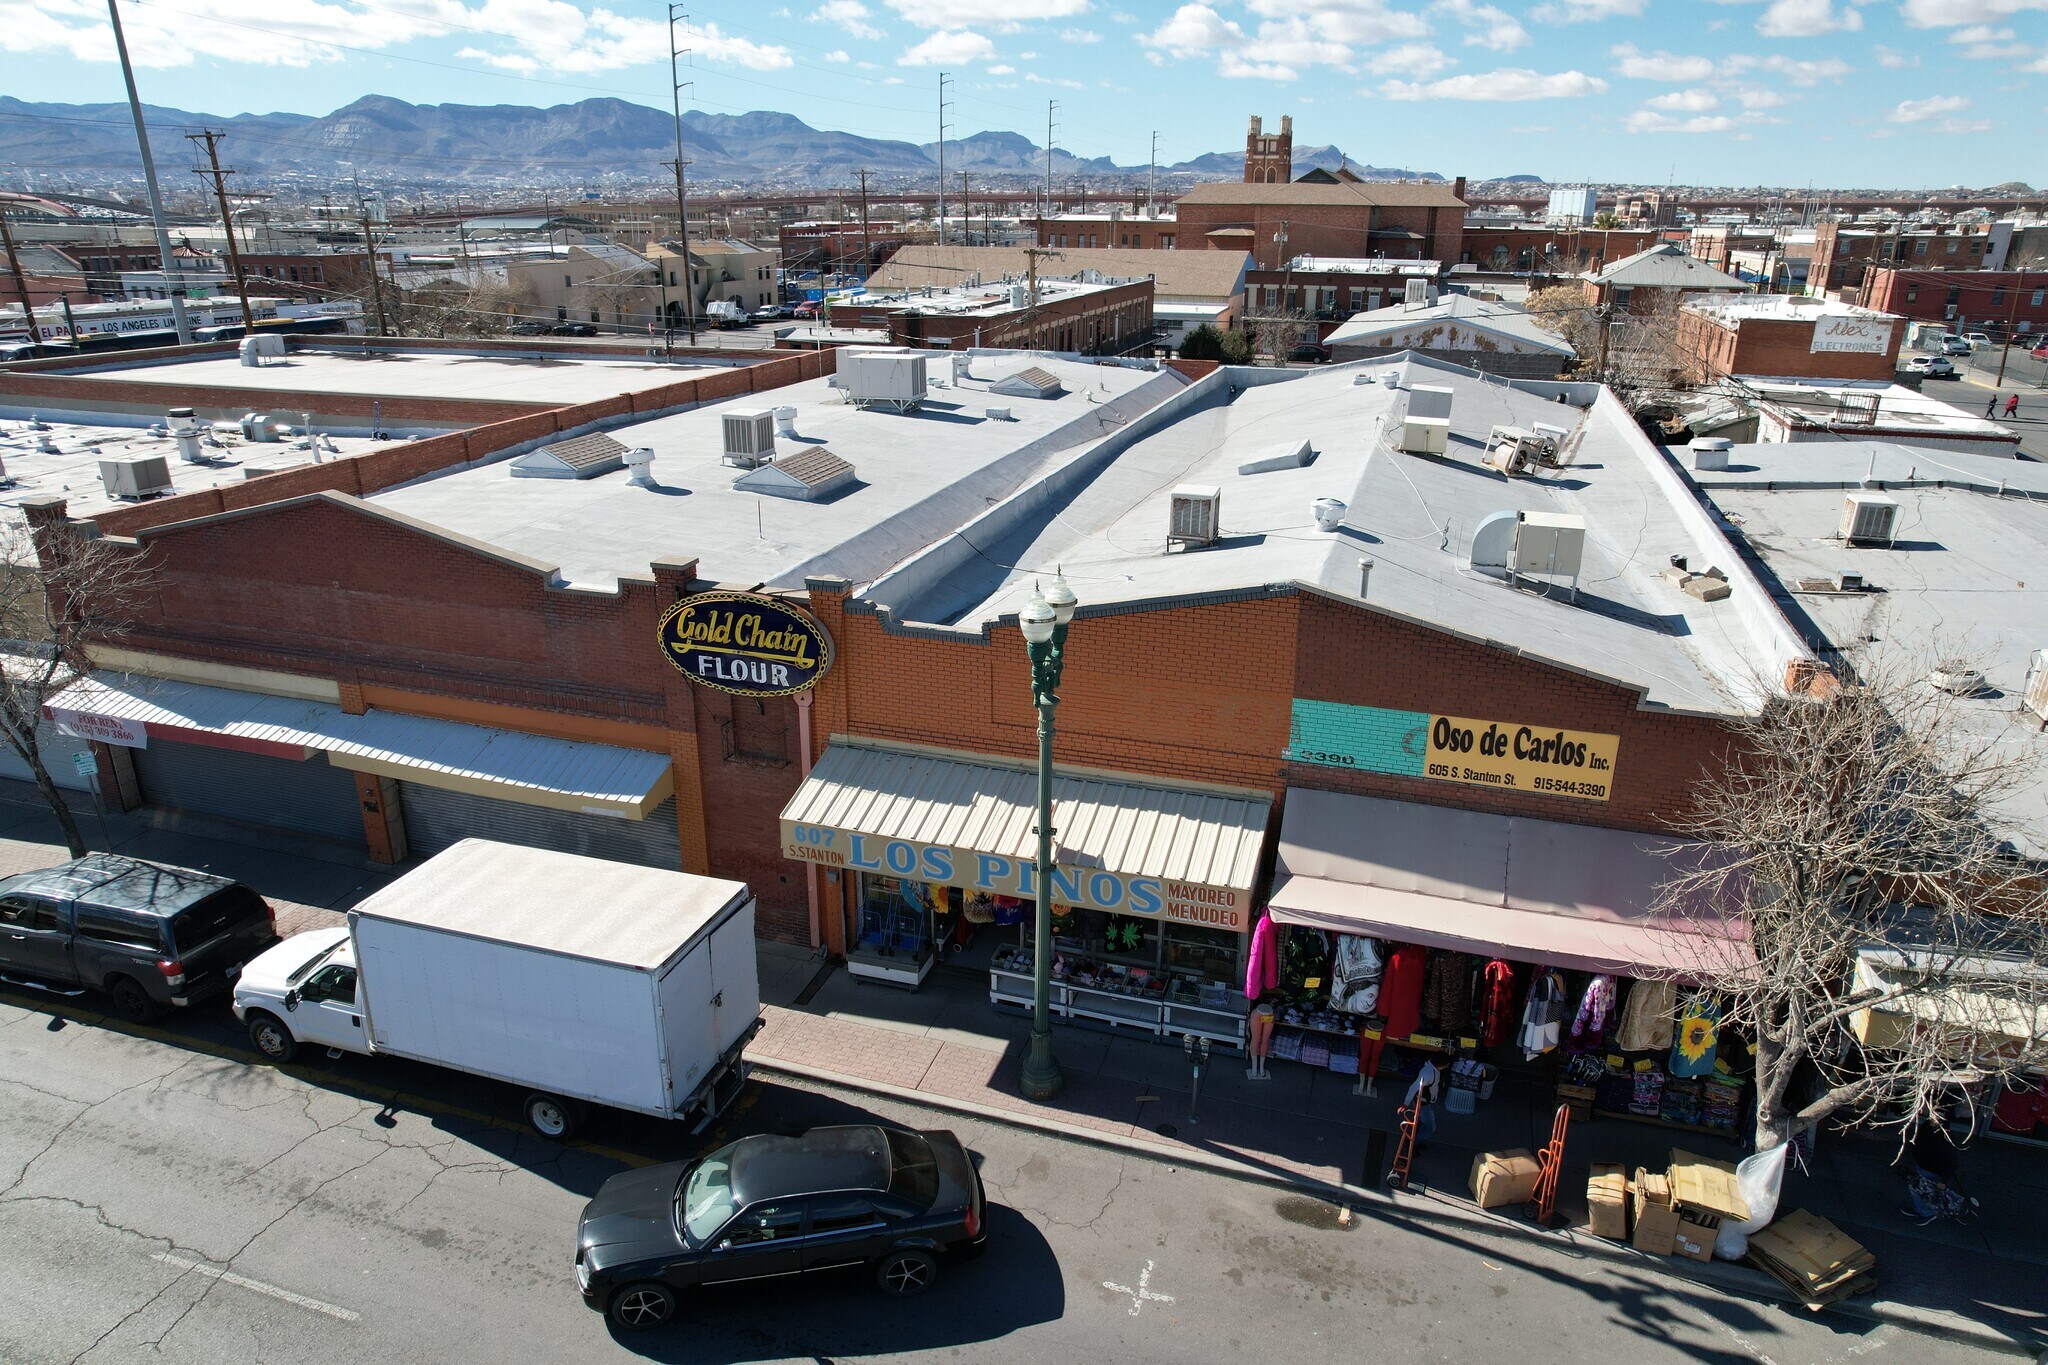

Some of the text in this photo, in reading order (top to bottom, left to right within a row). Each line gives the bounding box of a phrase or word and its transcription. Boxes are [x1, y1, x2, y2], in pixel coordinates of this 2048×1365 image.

[41, 327, 54, 338] EL
[55, 325, 83, 337] PAO
[102, 322, 119, 333] LOS
[121, 318, 160, 331] ANGELES
[1812, 341, 1884, 352] ELECTRONICS
[677, 606, 808, 653] Gold Chain
[697, 654, 790, 687] FLOUR
[70, 721, 134, 741] (915) 309 3860
[77, 714, 125, 730] FOR RENT
[1433, 716, 1610, 771] Oso de Carlos Inc.
[1428, 763, 1606, 798] 605 S. Stanton St. 915-544-3390
[794, 825, 836, 847] 607
[789, 844, 845, 865] S.STANTON
[848, 833, 1163, 914] LOS PINOS
[1167, 882, 1236, 907] MAYOREO
[1166, 901, 1239, 928] MENUDEO
